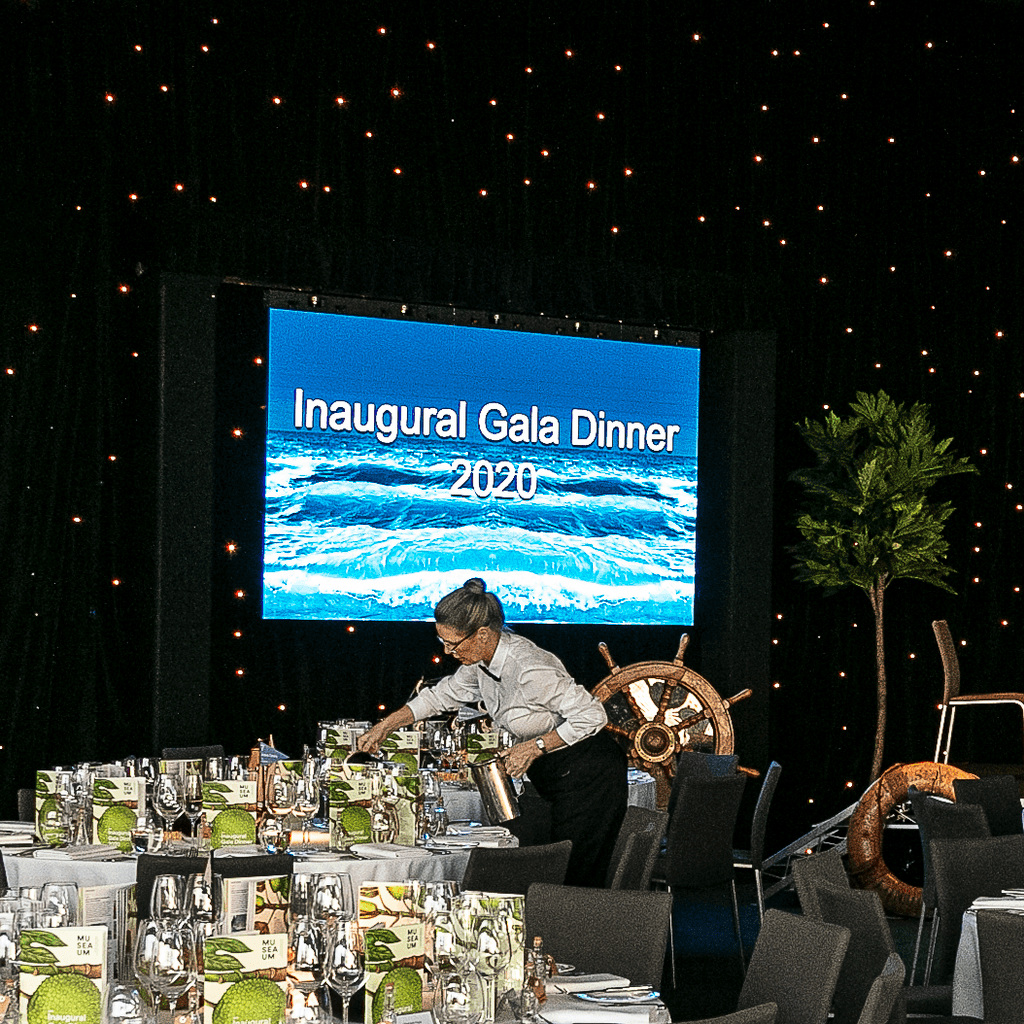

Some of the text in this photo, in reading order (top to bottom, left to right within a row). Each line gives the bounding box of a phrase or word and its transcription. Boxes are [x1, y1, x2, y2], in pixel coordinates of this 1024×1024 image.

[294, 388, 681, 452] Inaugural Gala Dinner
[450, 459, 538, 500] 2020
[47, 1014, 87, 1022] Inaugural
